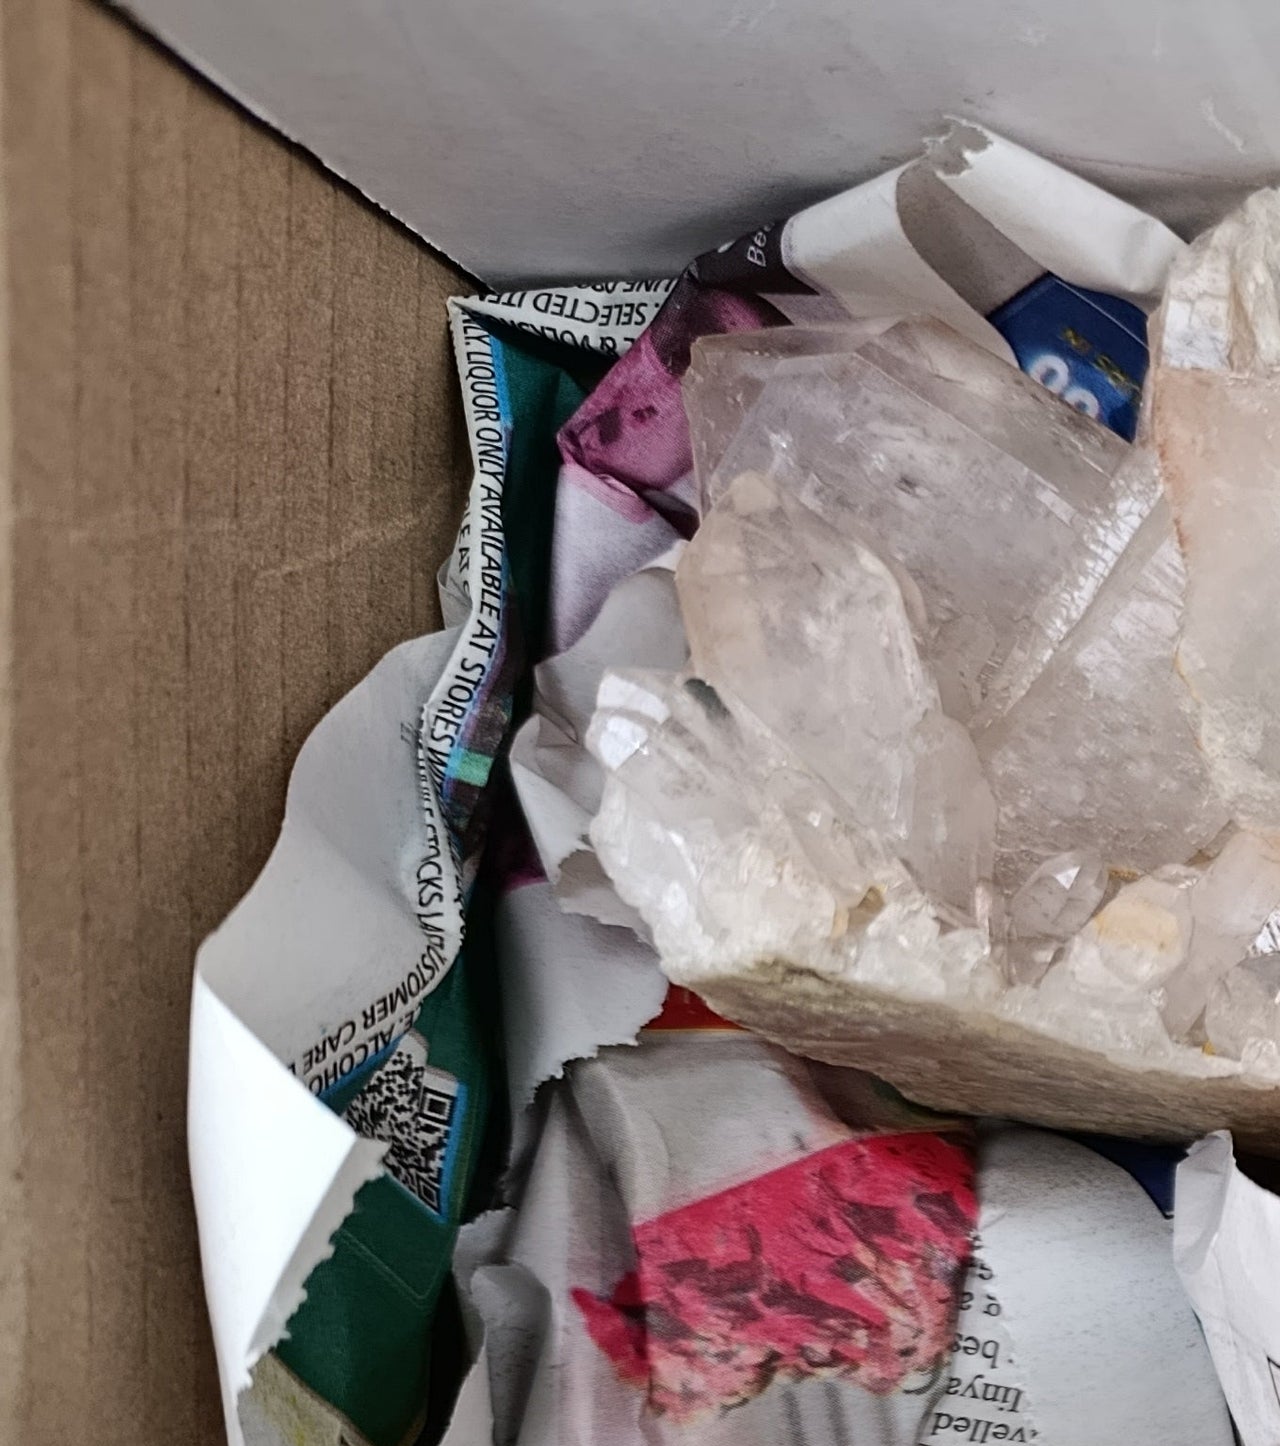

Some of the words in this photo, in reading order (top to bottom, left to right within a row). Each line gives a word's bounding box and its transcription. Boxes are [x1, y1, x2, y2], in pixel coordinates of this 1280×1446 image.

[533, 292, 647, 326] SELECTED
[465, 351, 501, 422] LIQUOR
[475, 427, 504, 486] ONLY
[480, 484, 503, 620] AVAILABLE
[468, 619, 498, 658] AT
[430, 657, 486, 748] STORES
[362, 944, 447, 1029] USTOMER
[302, 1020, 356, 1075] CARE
[931, 1411, 1042, 1444] velled
